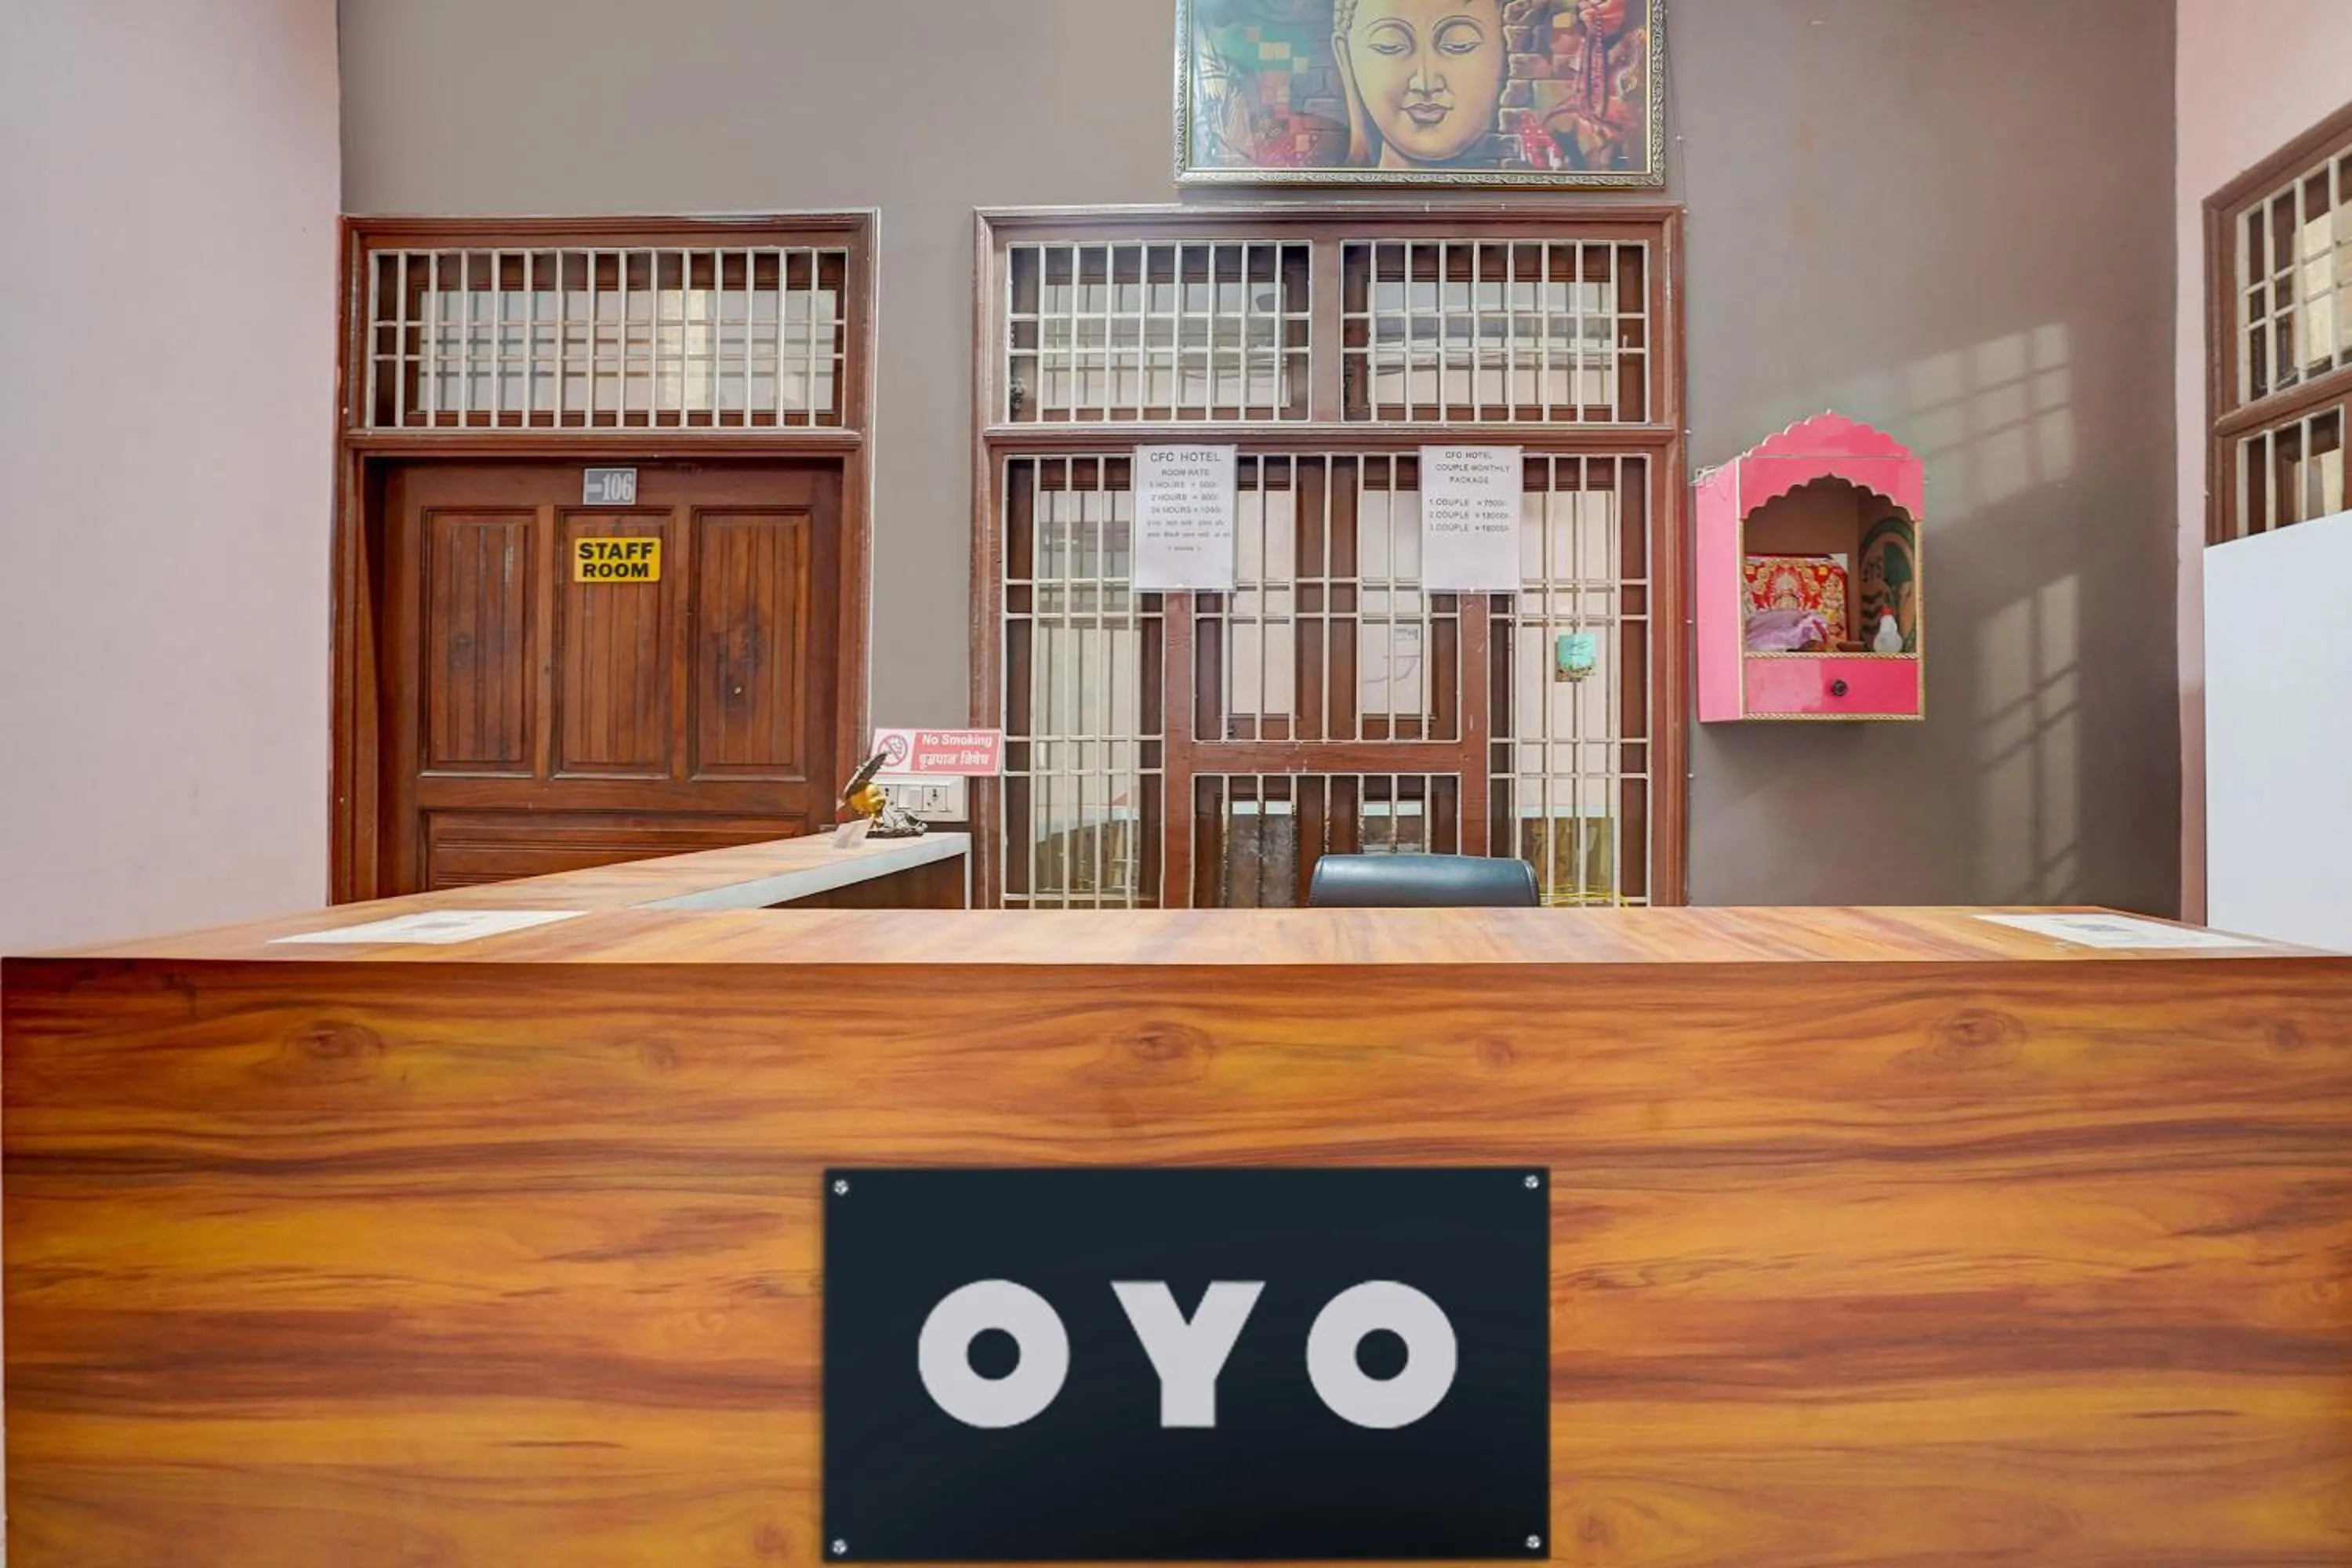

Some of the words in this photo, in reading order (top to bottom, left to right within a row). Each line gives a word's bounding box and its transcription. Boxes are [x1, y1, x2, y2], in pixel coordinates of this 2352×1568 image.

[1150, 452, 1174, 463] CFC
[1180, 452, 1221, 463] HOTEL
[1465, 451, 1493, 460] HOTEL
[1161, 468, 1185, 477] ROOM
[1188, 468, 1210, 477] RATE
[1435, 463, 1469, 472] COUPLE
[1471, 463, 1511, 474] MONTHLY
[1449, 475, 1489, 485] PACKAGE
[1436, 498, 1469, 506] COUPLE
[1162, 506, 1192, 514] HOURS
[1436, 510, 1469, 519] COUPLE
[1436, 523, 1469, 532] COUPLE
[579, 542, 655, 560] STAFF
[583, 563, 649, 578] ROOM
[921, 733, 939, 746] No
[941, 734, 993, 748] Smoking
[917, 1278, 1459, 1430] OYO
